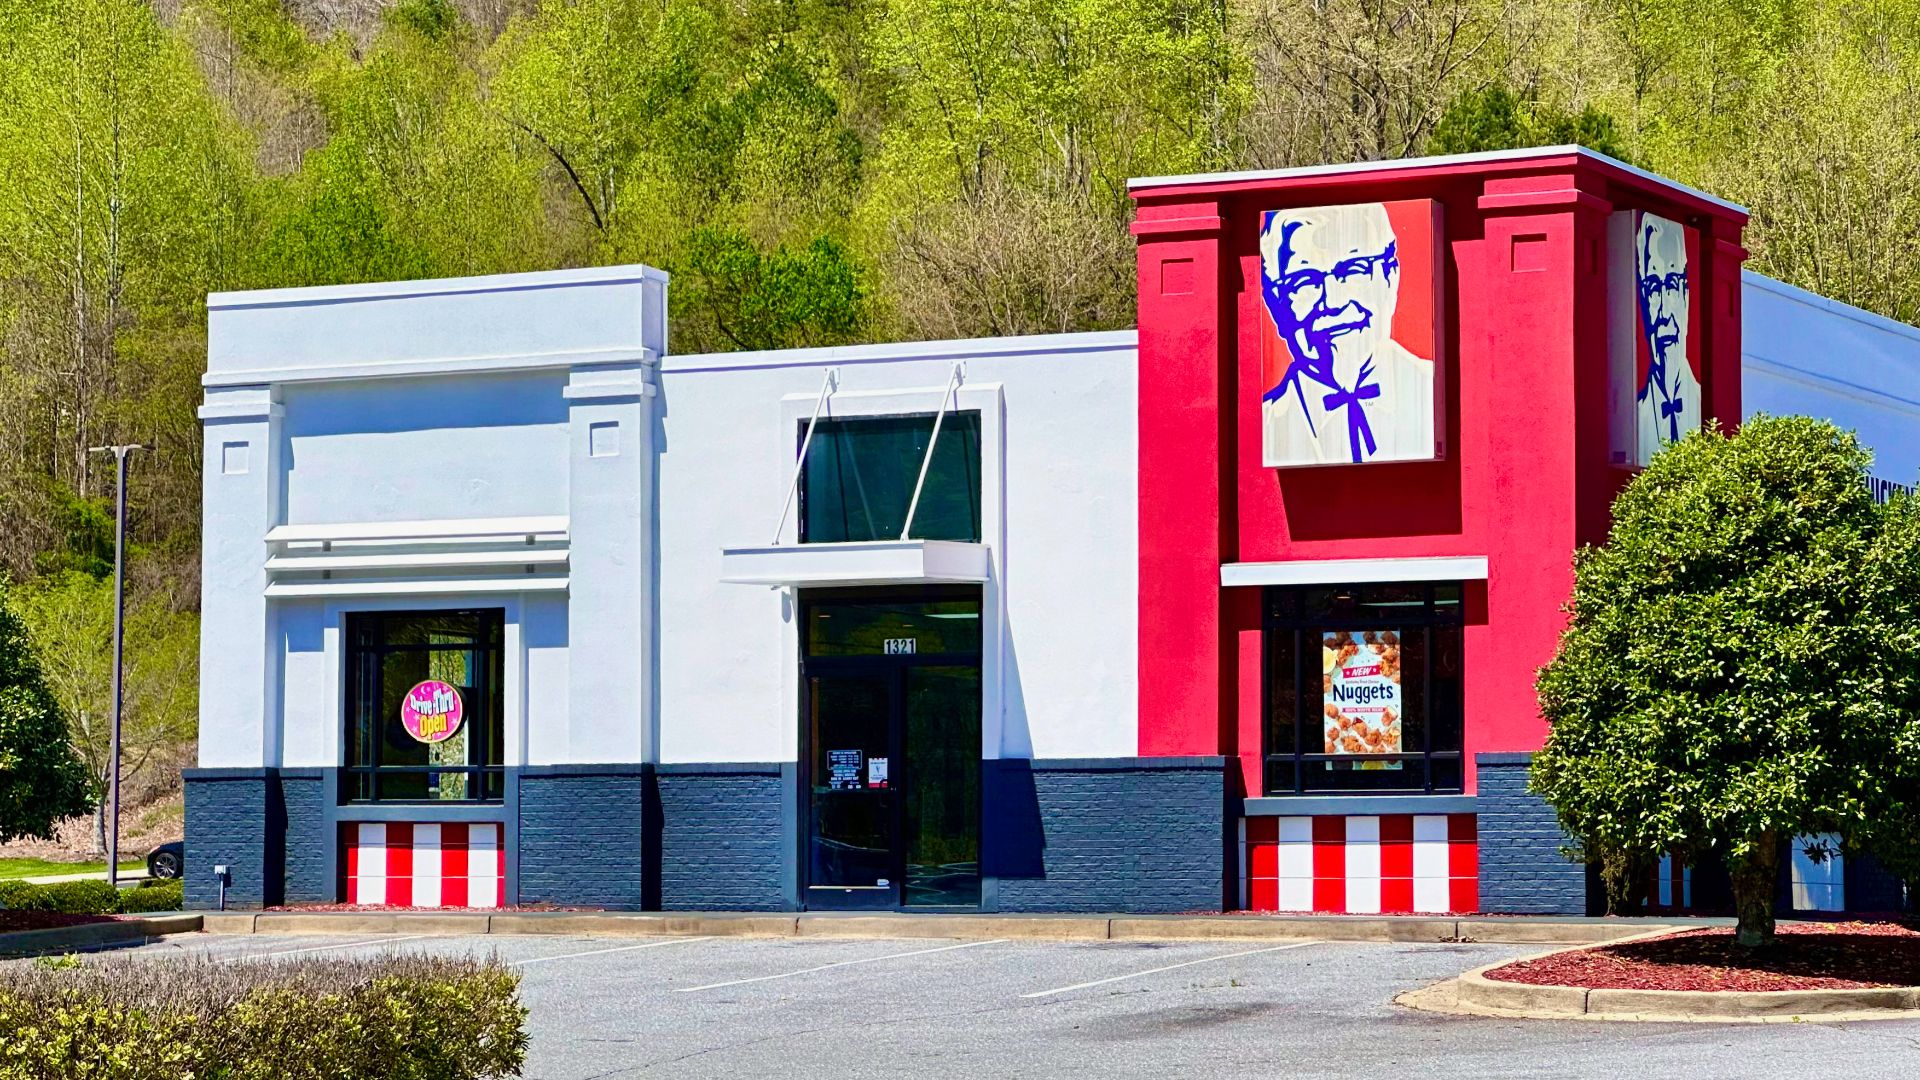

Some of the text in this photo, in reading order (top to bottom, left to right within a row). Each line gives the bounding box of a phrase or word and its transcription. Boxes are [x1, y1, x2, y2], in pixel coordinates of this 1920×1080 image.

[886, 639, 914, 654] 1321
[1351, 666, 1373, 677] NEW
[409, 688, 455, 716] Drive-Thru
[1333, 683, 1393, 704] Nuggets
[419, 713, 448, 740] Open
